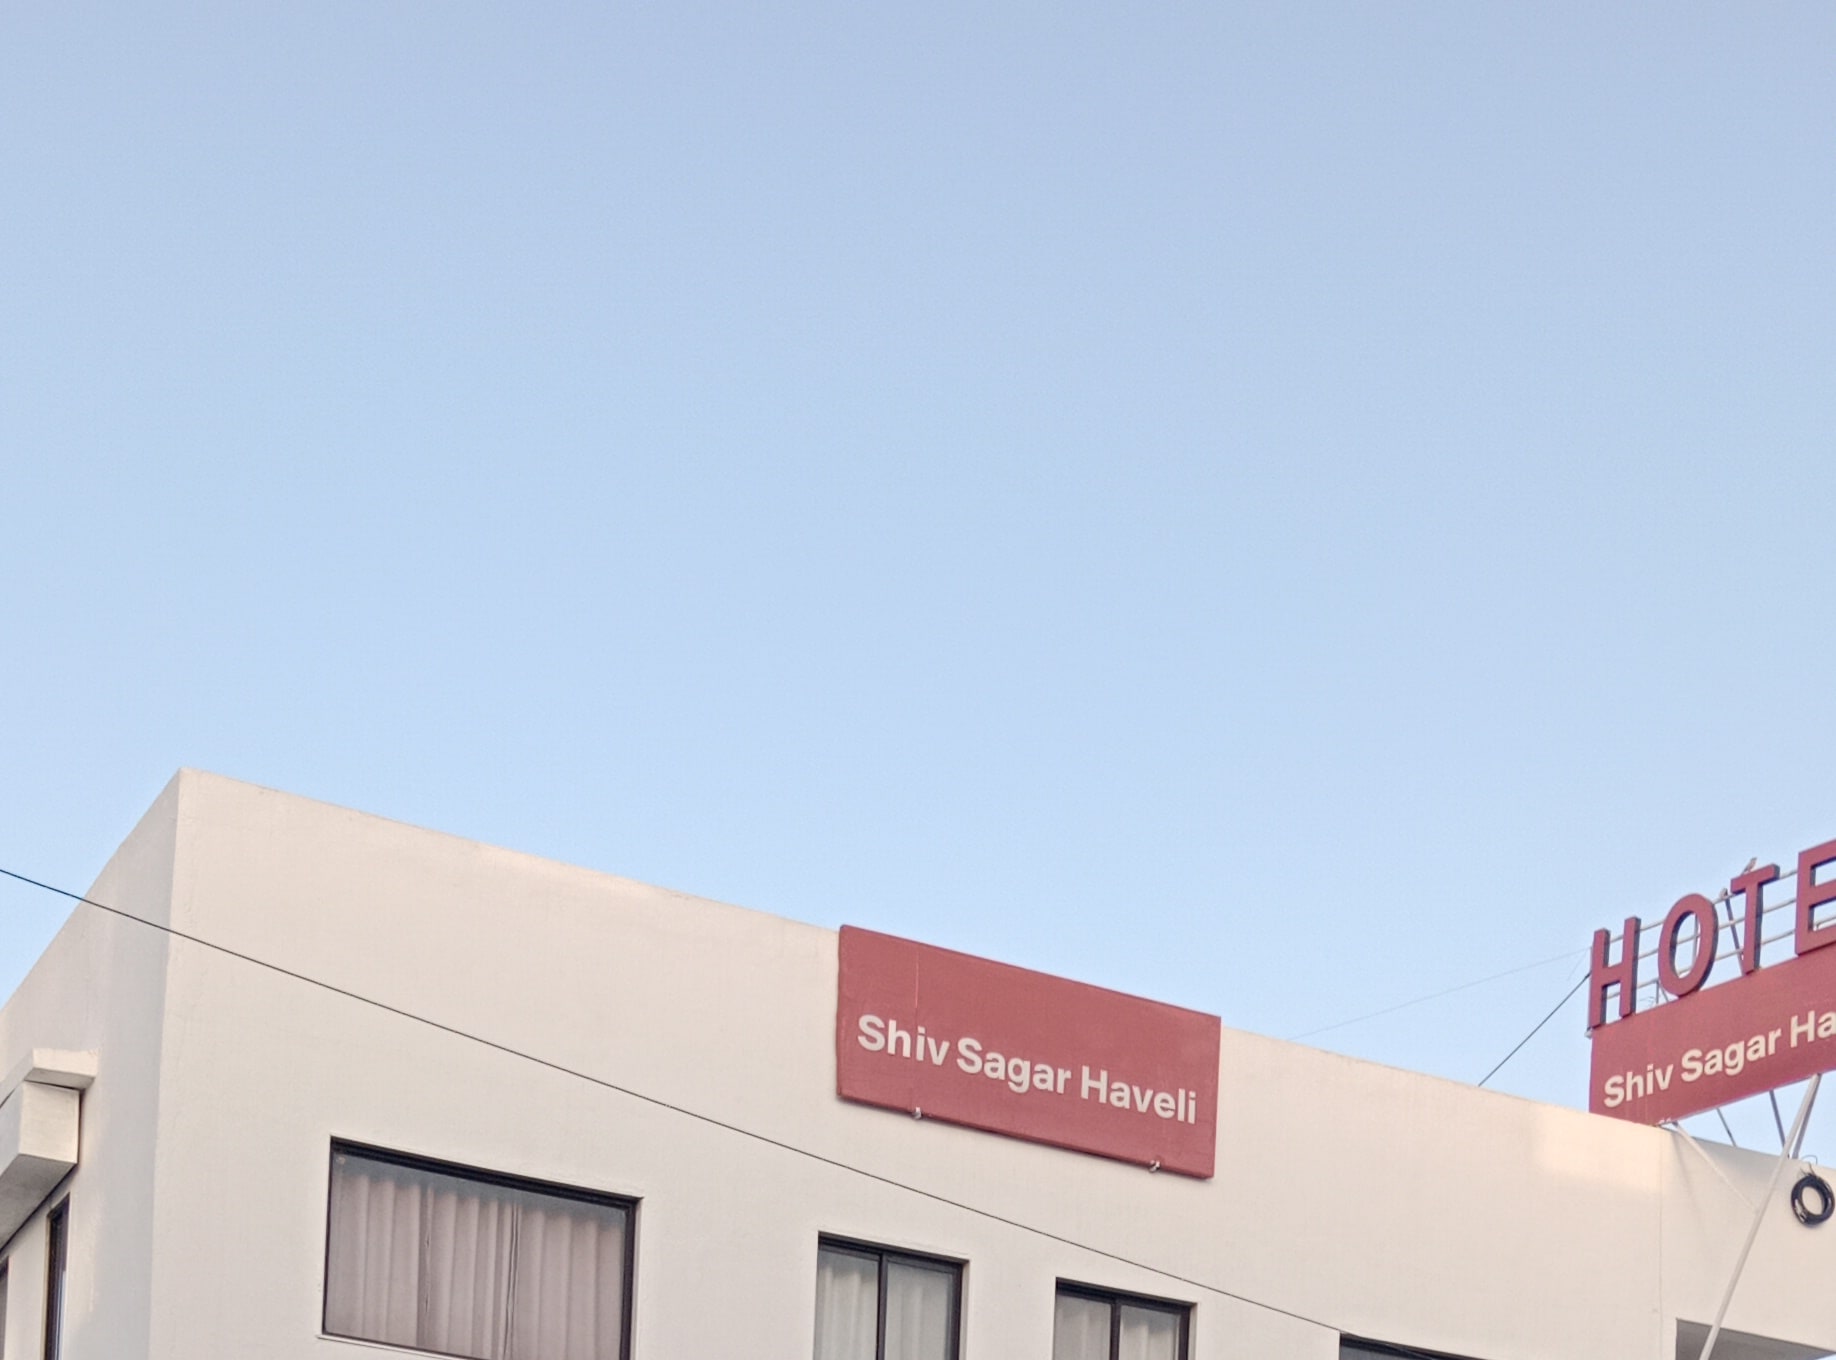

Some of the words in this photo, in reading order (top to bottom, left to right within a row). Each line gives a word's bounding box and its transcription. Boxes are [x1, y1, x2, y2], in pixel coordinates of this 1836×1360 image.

[857, 1013, 950, 1066] Shiv
[956, 1036, 1071, 1094] Sagar
[1080, 1065, 1196, 1125] Haveli
[1603, 1063, 1674, 1108] Shiv
[1680, 1027, 1782, 1083] Sagar
[1789, 1010, 1836, 1048] Ha
